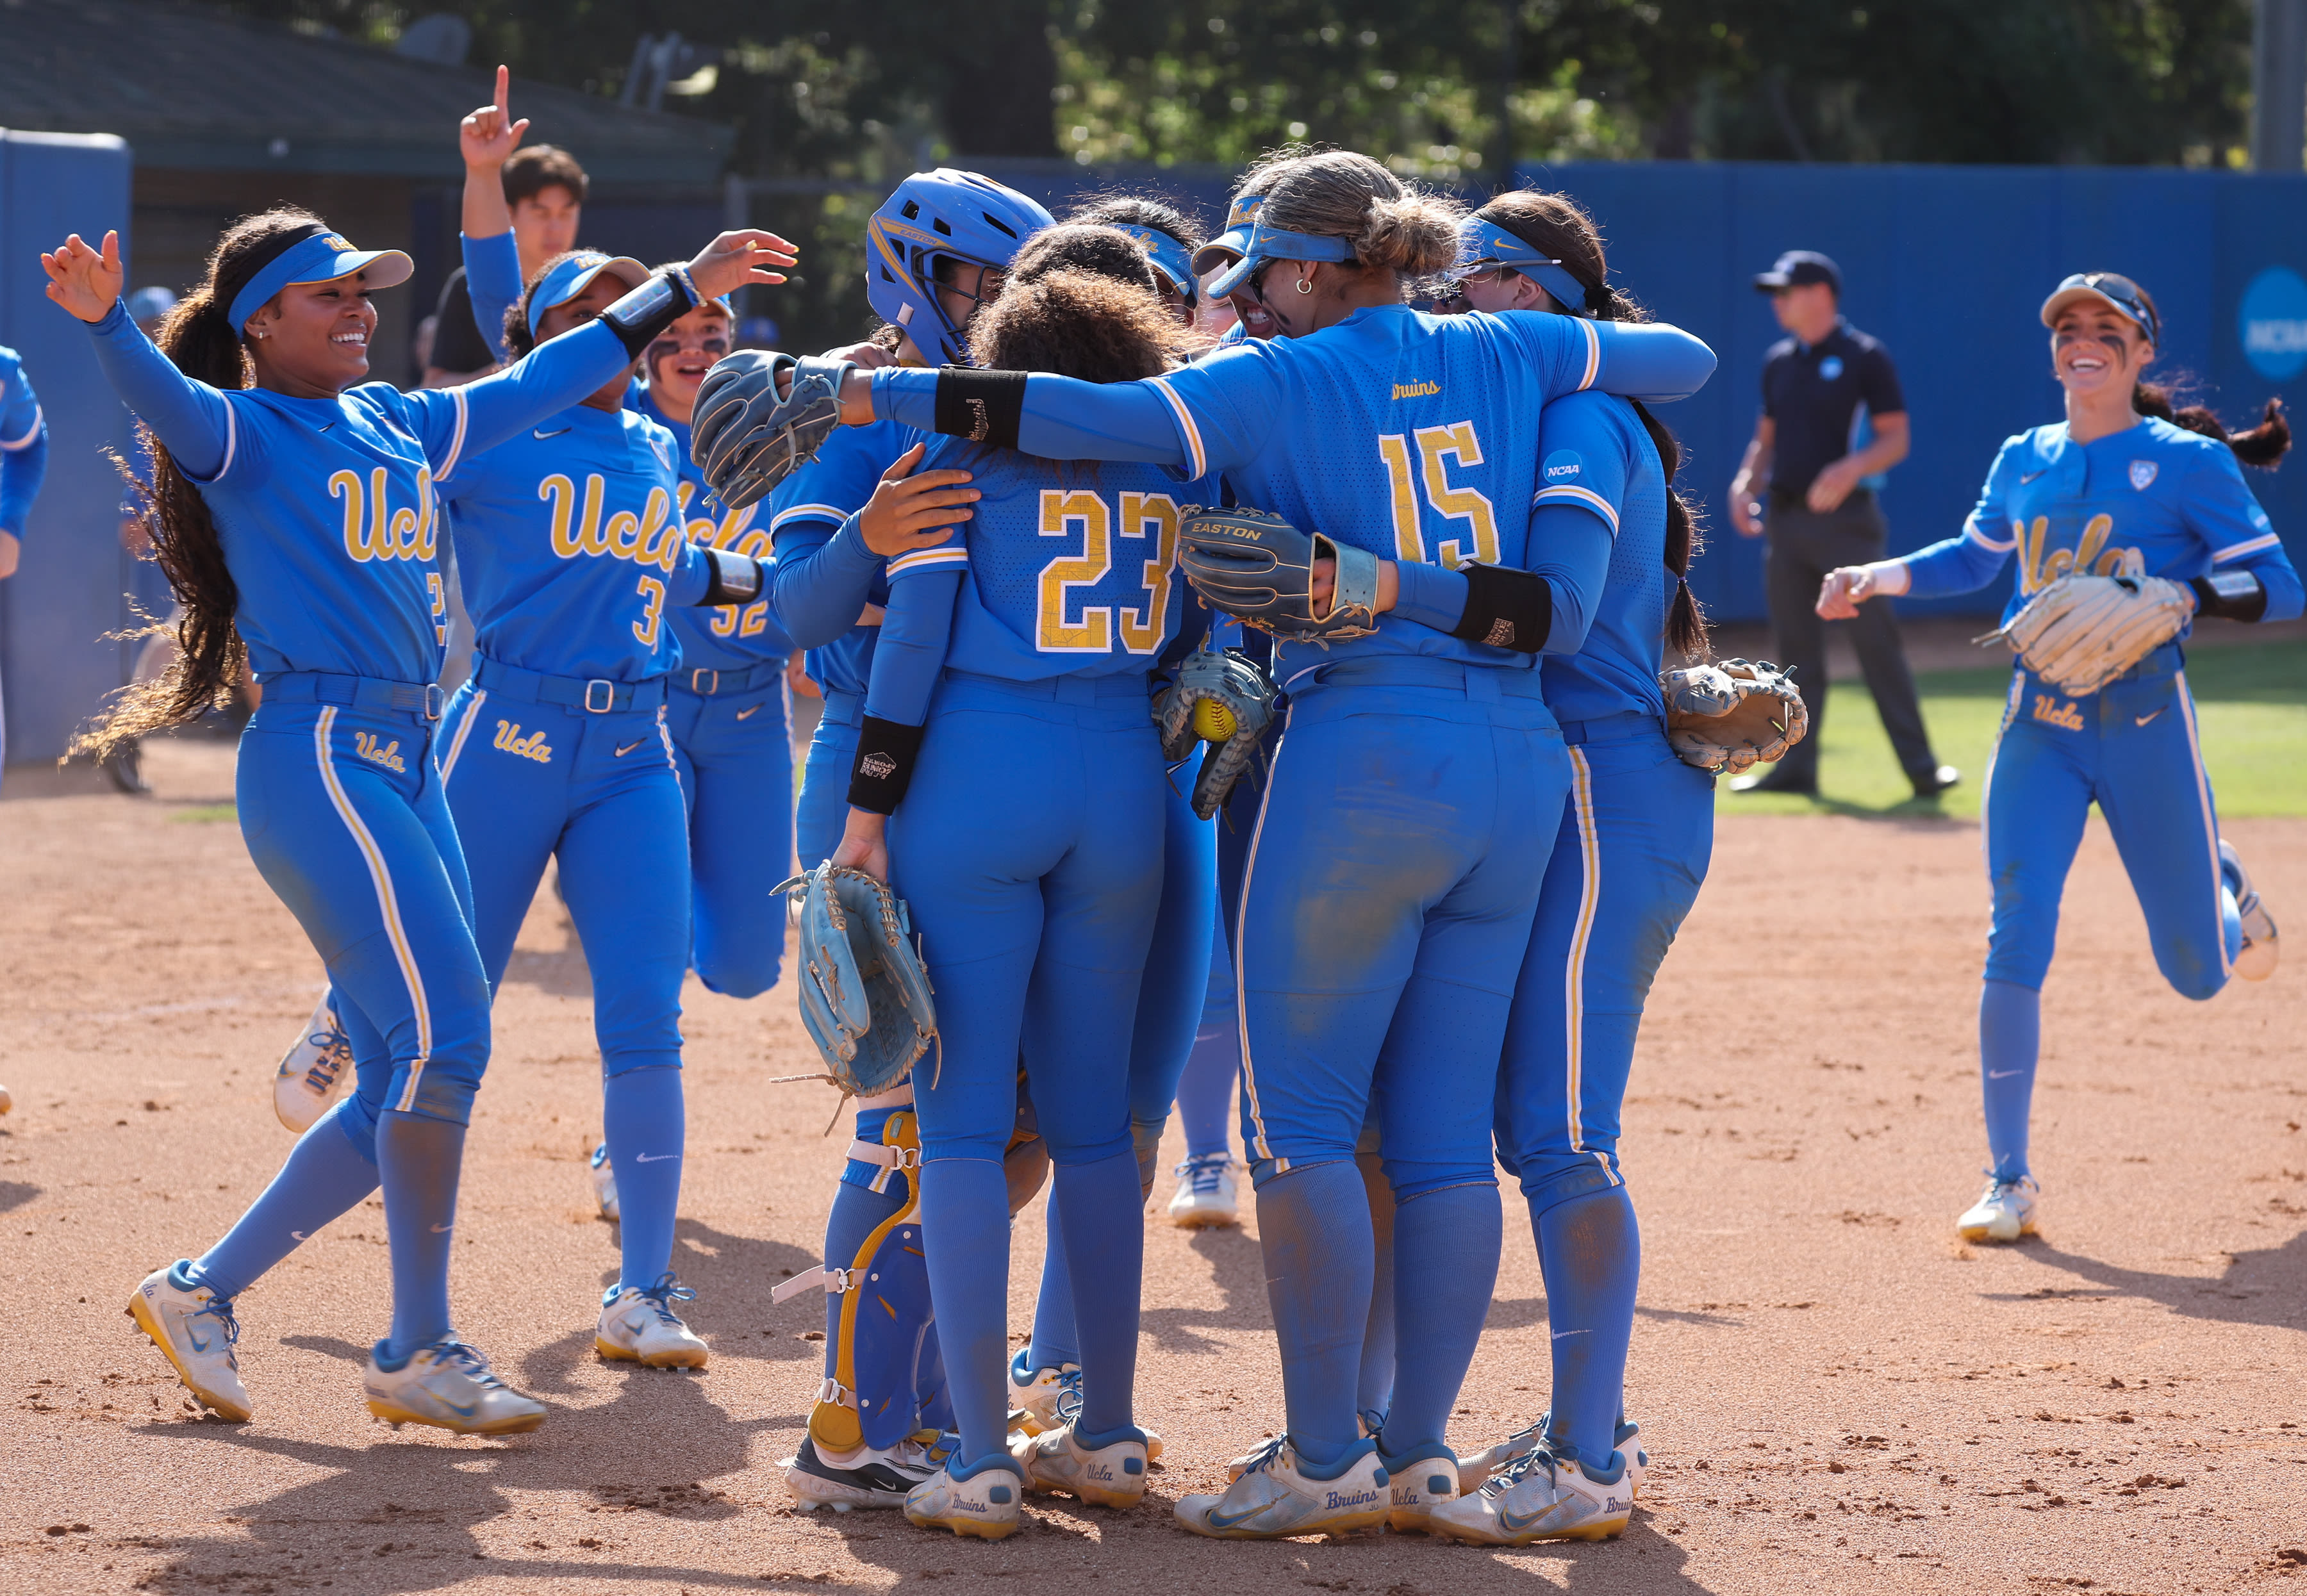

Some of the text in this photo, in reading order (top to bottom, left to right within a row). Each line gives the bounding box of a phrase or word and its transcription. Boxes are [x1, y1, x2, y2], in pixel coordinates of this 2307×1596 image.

[900, 229, 938, 244] EASTON
[1548, 465, 1579, 477] NCAA
[1378, 420, 1501, 571] 15
[327, 466, 438, 563] Ucl
[1192, 523, 1262, 541] EASTON
[1035, 489, 1179, 655] 23
[2033, 695, 2085, 731] Ucla
[493, 720, 552, 763] Ucla
[355, 732, 406, 773] Ucla
[1087, 1463, 1114, 1481] Ucla
[952, 1492, 988, 1513] Bruins
[1325, 1489, 1380, 1510] Bruins
[1390, 1486, 1420, 1506] Ucla
[1604, 1496, 1632, 1514] Bruin
